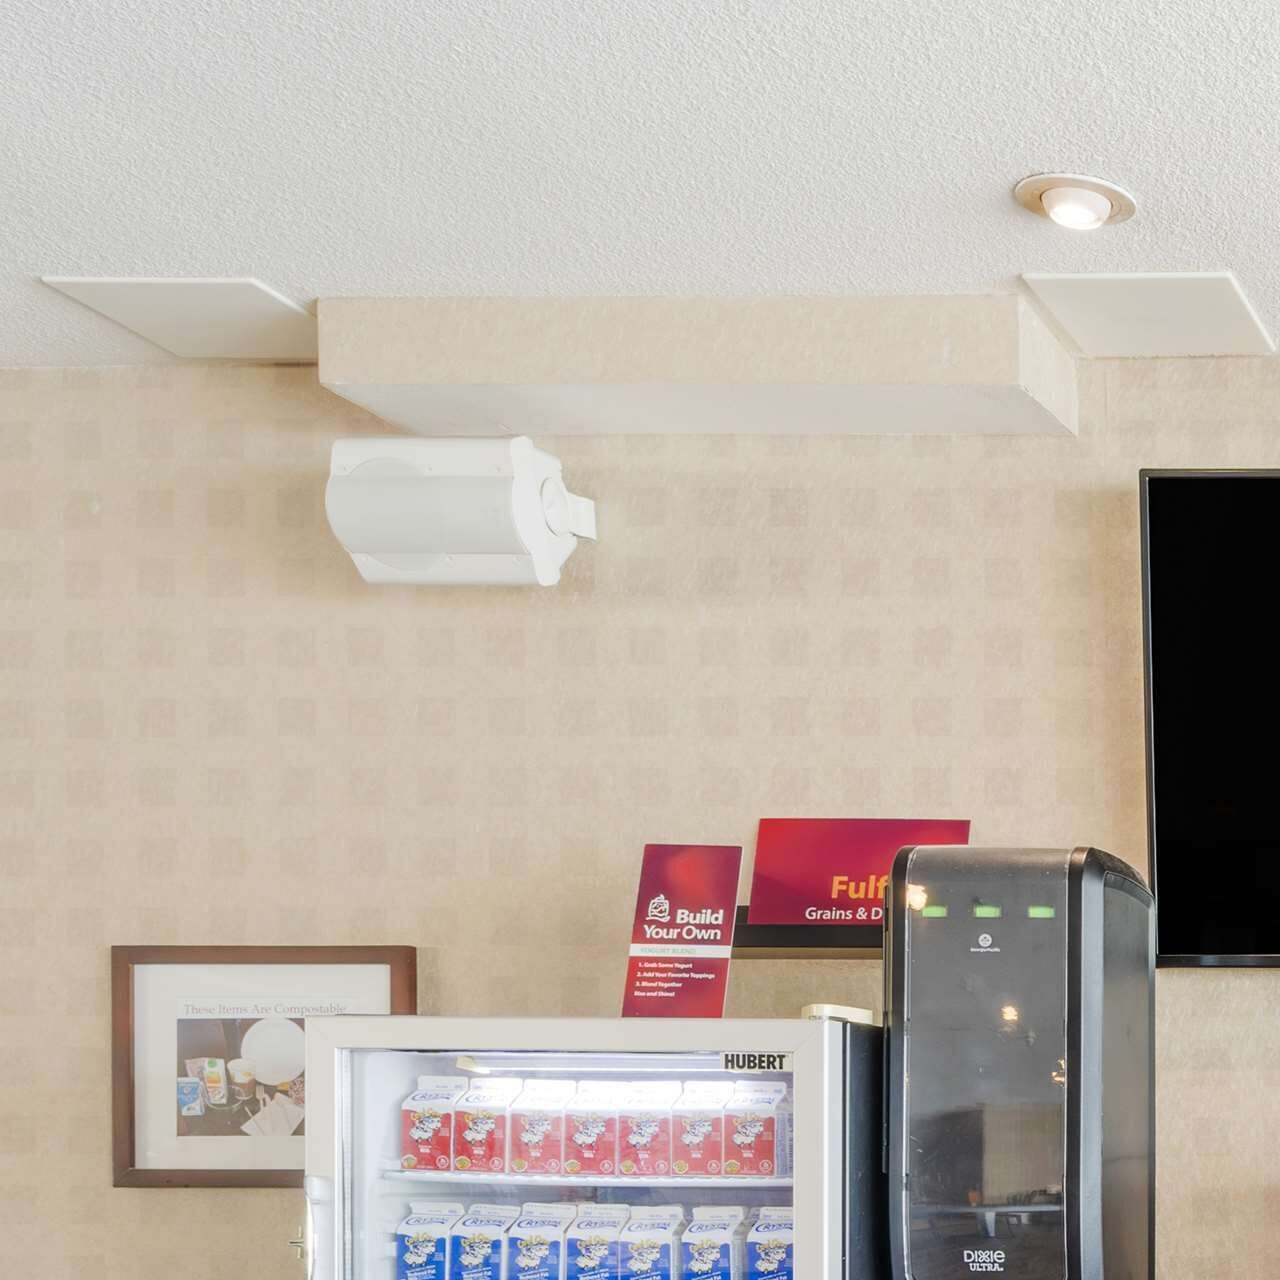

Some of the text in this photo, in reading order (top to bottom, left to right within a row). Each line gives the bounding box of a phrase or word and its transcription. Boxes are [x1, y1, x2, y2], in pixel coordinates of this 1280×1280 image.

[676, 909, 724, 925] Build
[805, 907, 853, 920] Grains
[856, 907, 868, 920] &
[643, 925, 721, 940] Your Own
[184, 1003, 347, 1017] These Items Are Compostable
[724, 1053, 786, 1070] HUBERT
[969, 1263, 1001, 1271] ULTRA
